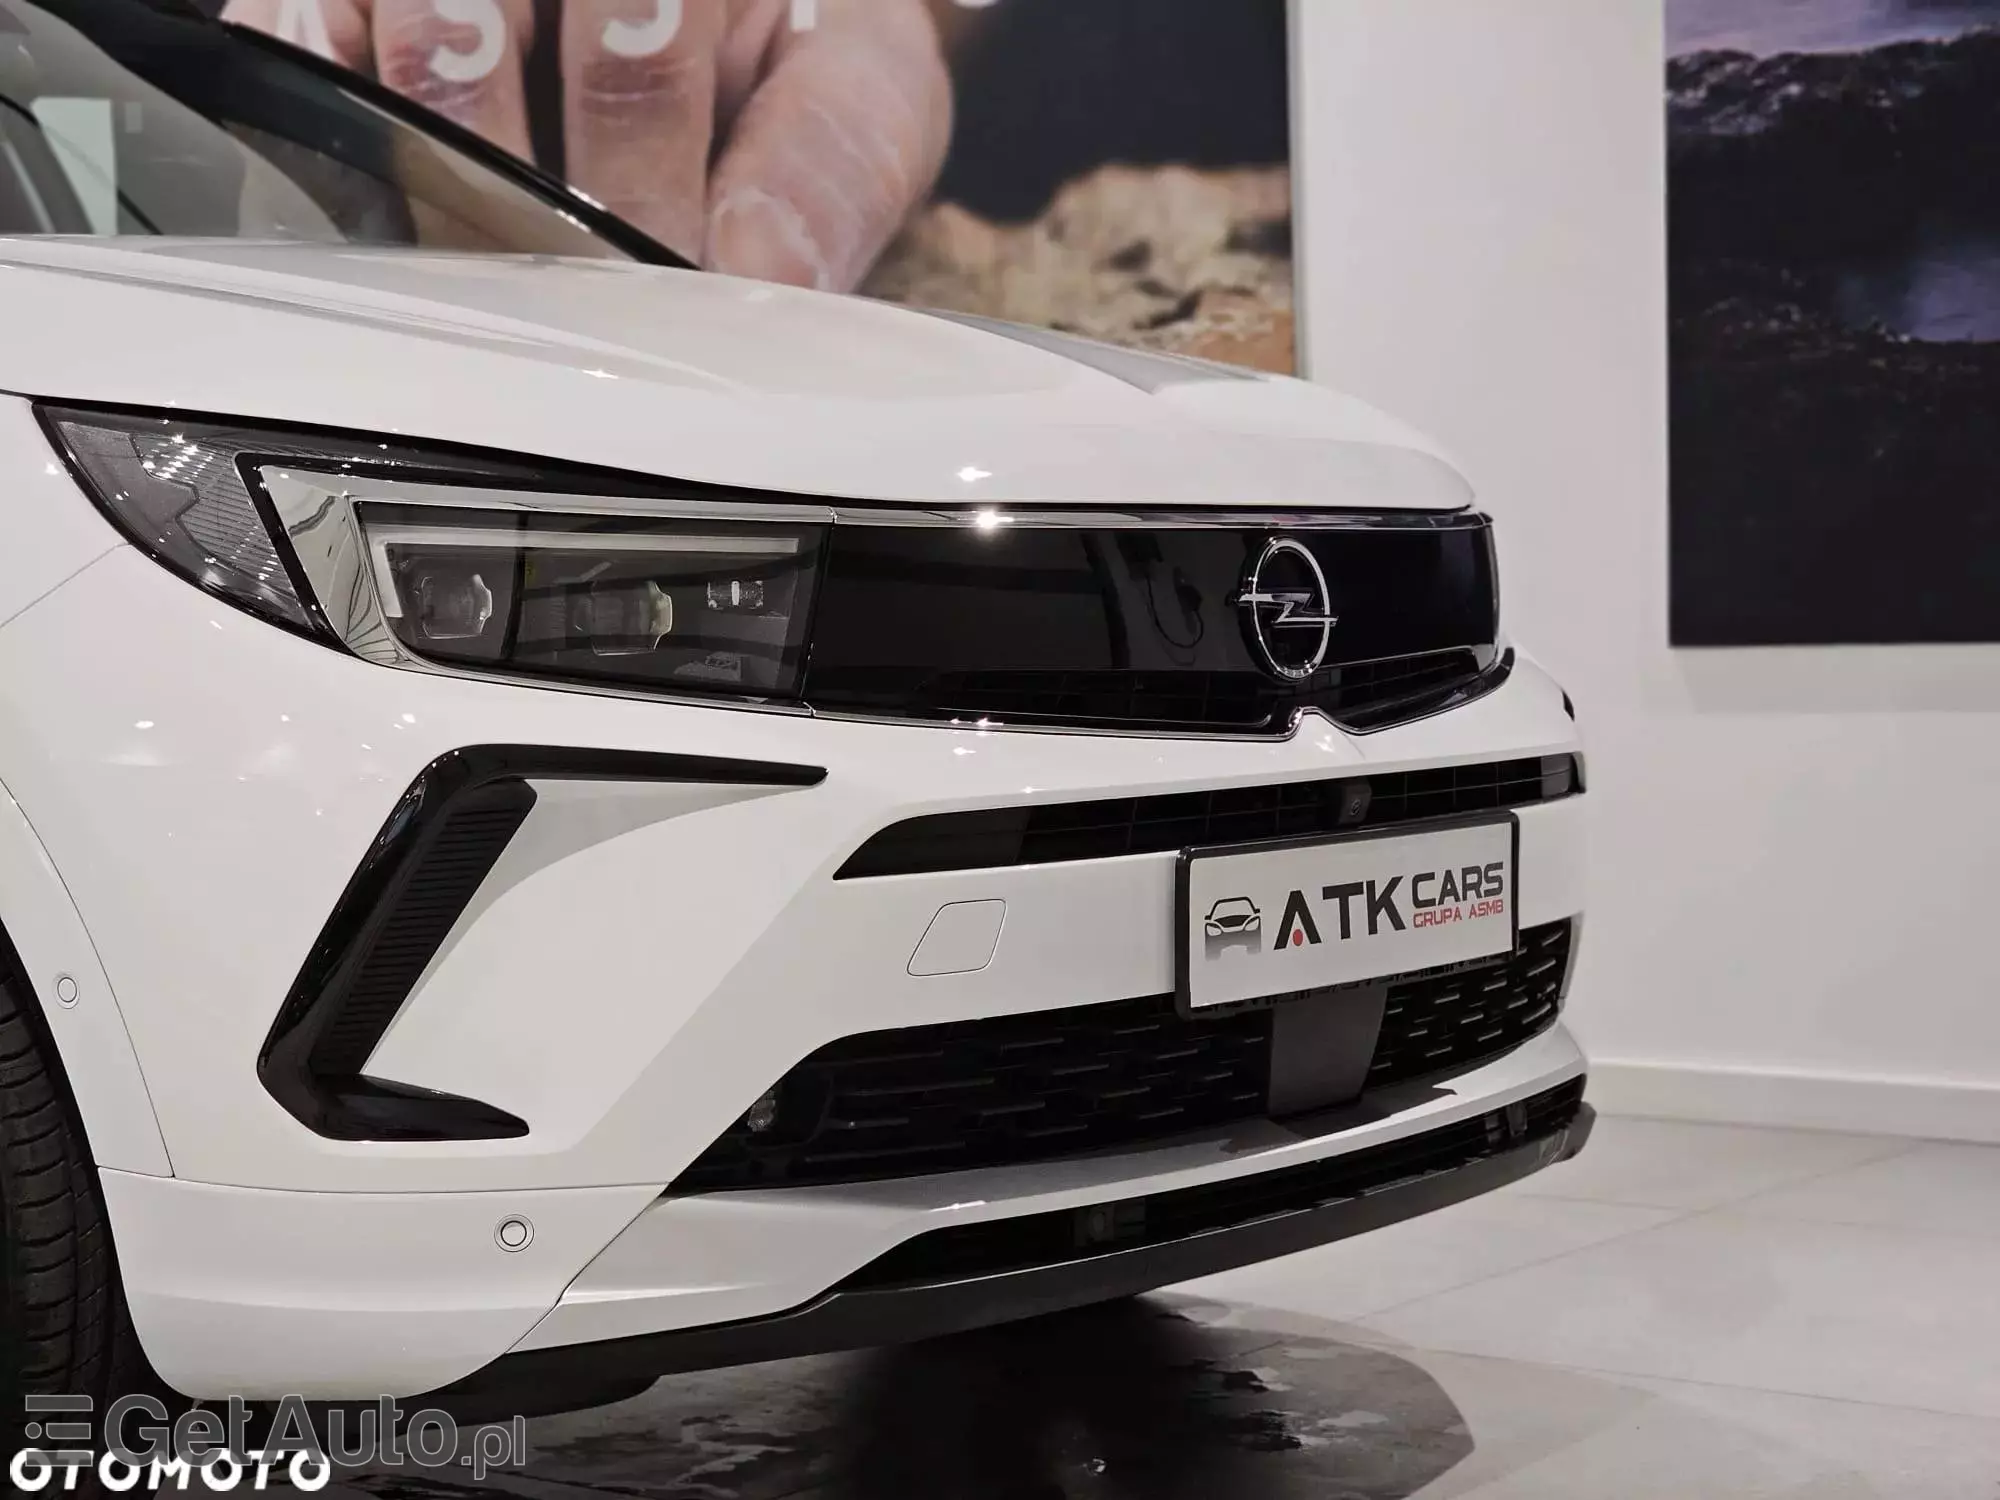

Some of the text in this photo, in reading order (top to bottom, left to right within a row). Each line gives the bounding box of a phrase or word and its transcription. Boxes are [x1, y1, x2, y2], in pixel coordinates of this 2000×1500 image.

[1274, 862, 1504, 950] ATK CARS
[1413, 900, 1504, 928] GRUPA ASMB
